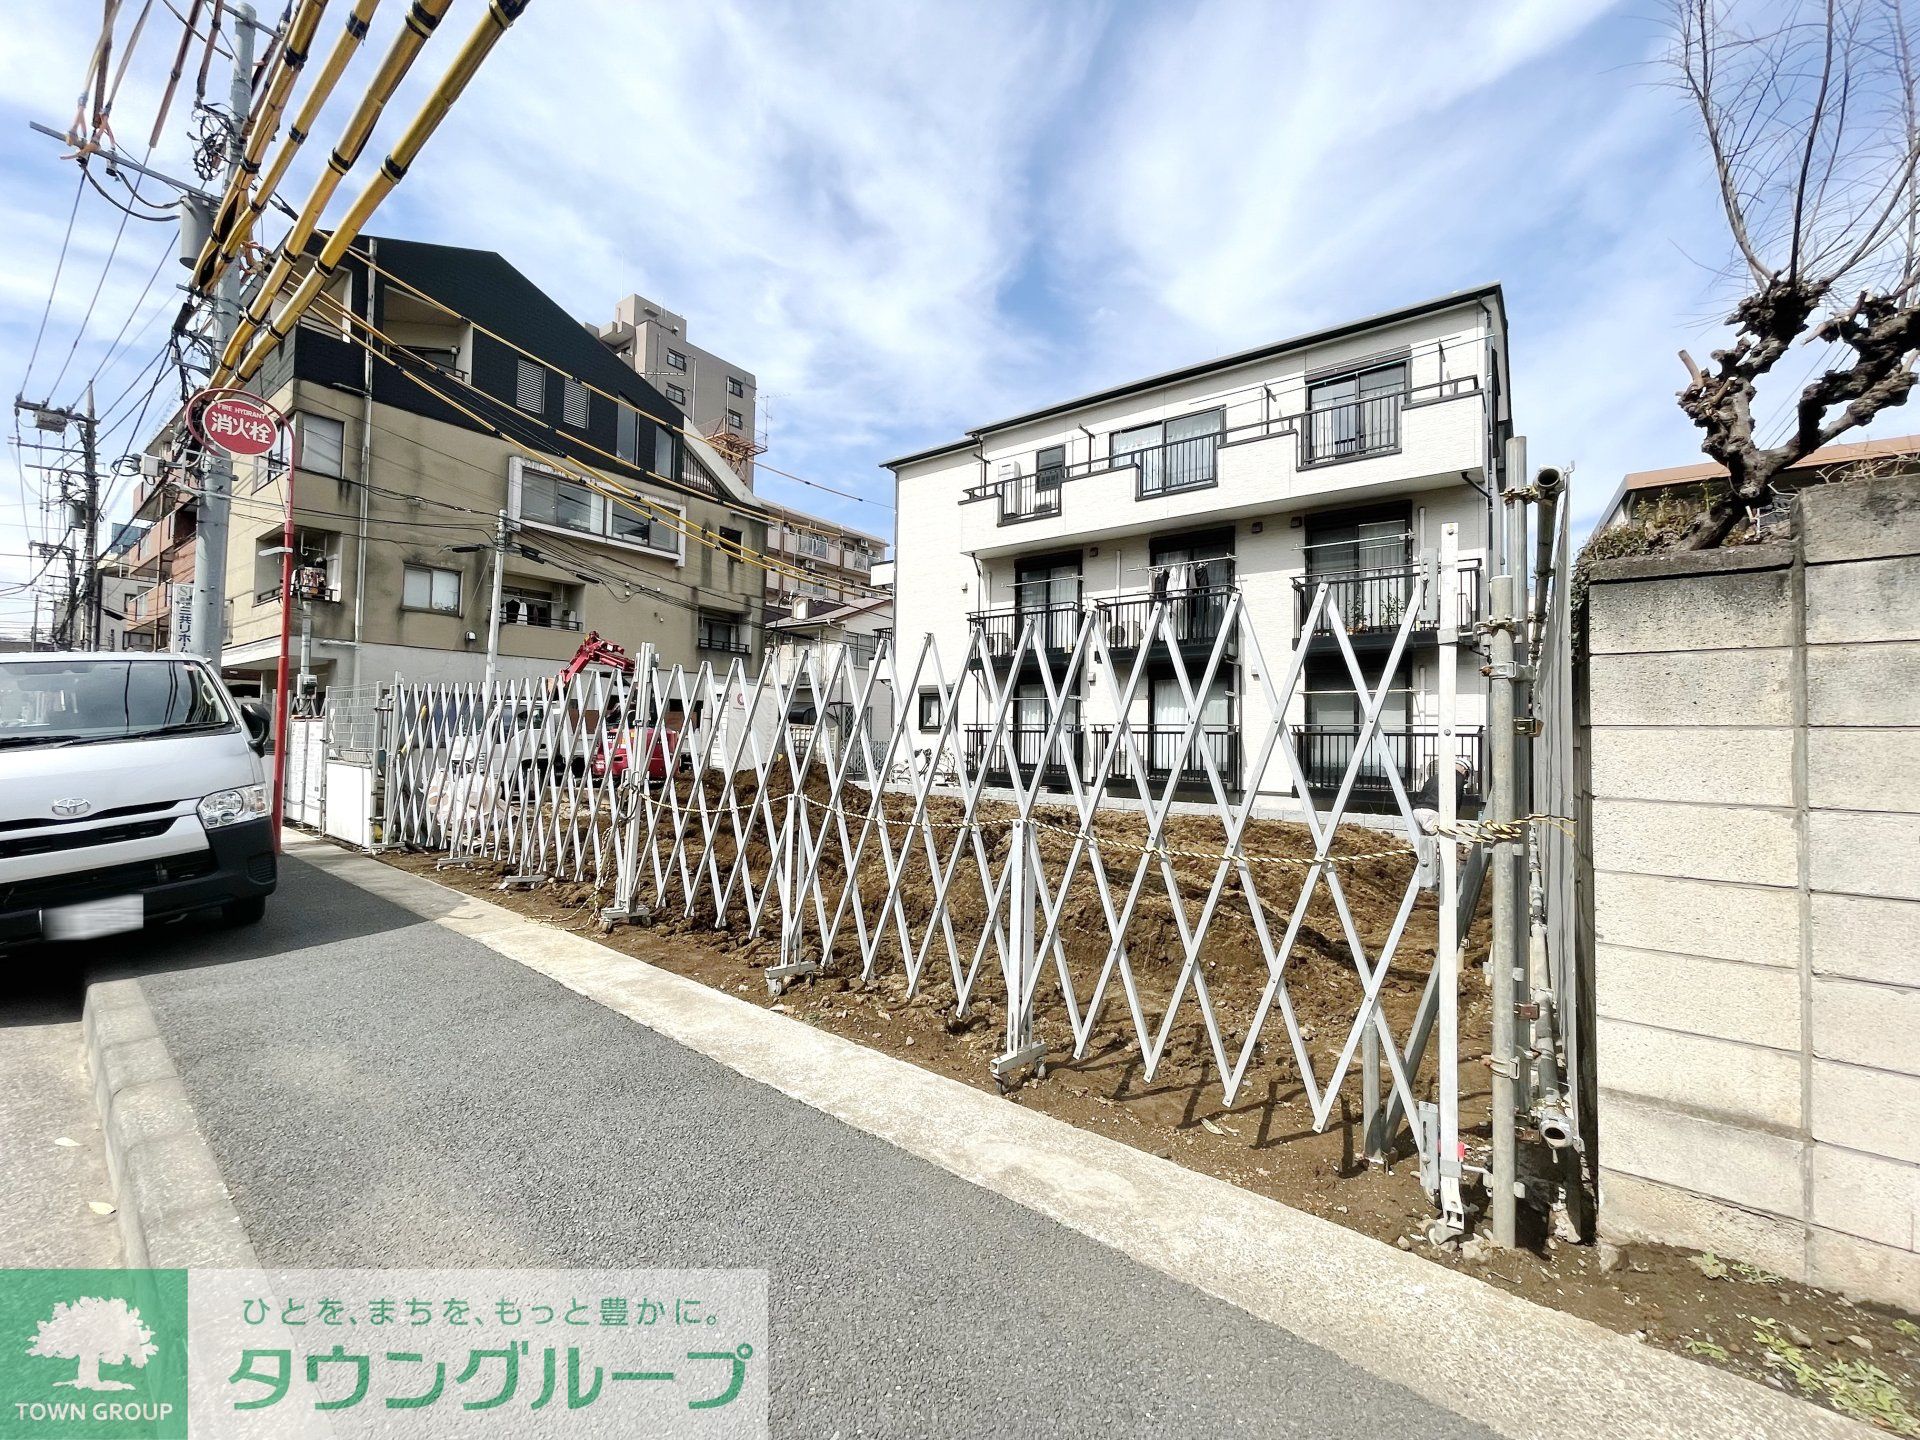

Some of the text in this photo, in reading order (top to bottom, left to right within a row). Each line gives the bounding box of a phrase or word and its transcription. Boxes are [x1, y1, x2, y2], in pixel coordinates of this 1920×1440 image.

[217, 403, 266, 419] FIRE HYDRANT
[211, 411, 272, 444] 消火栓
